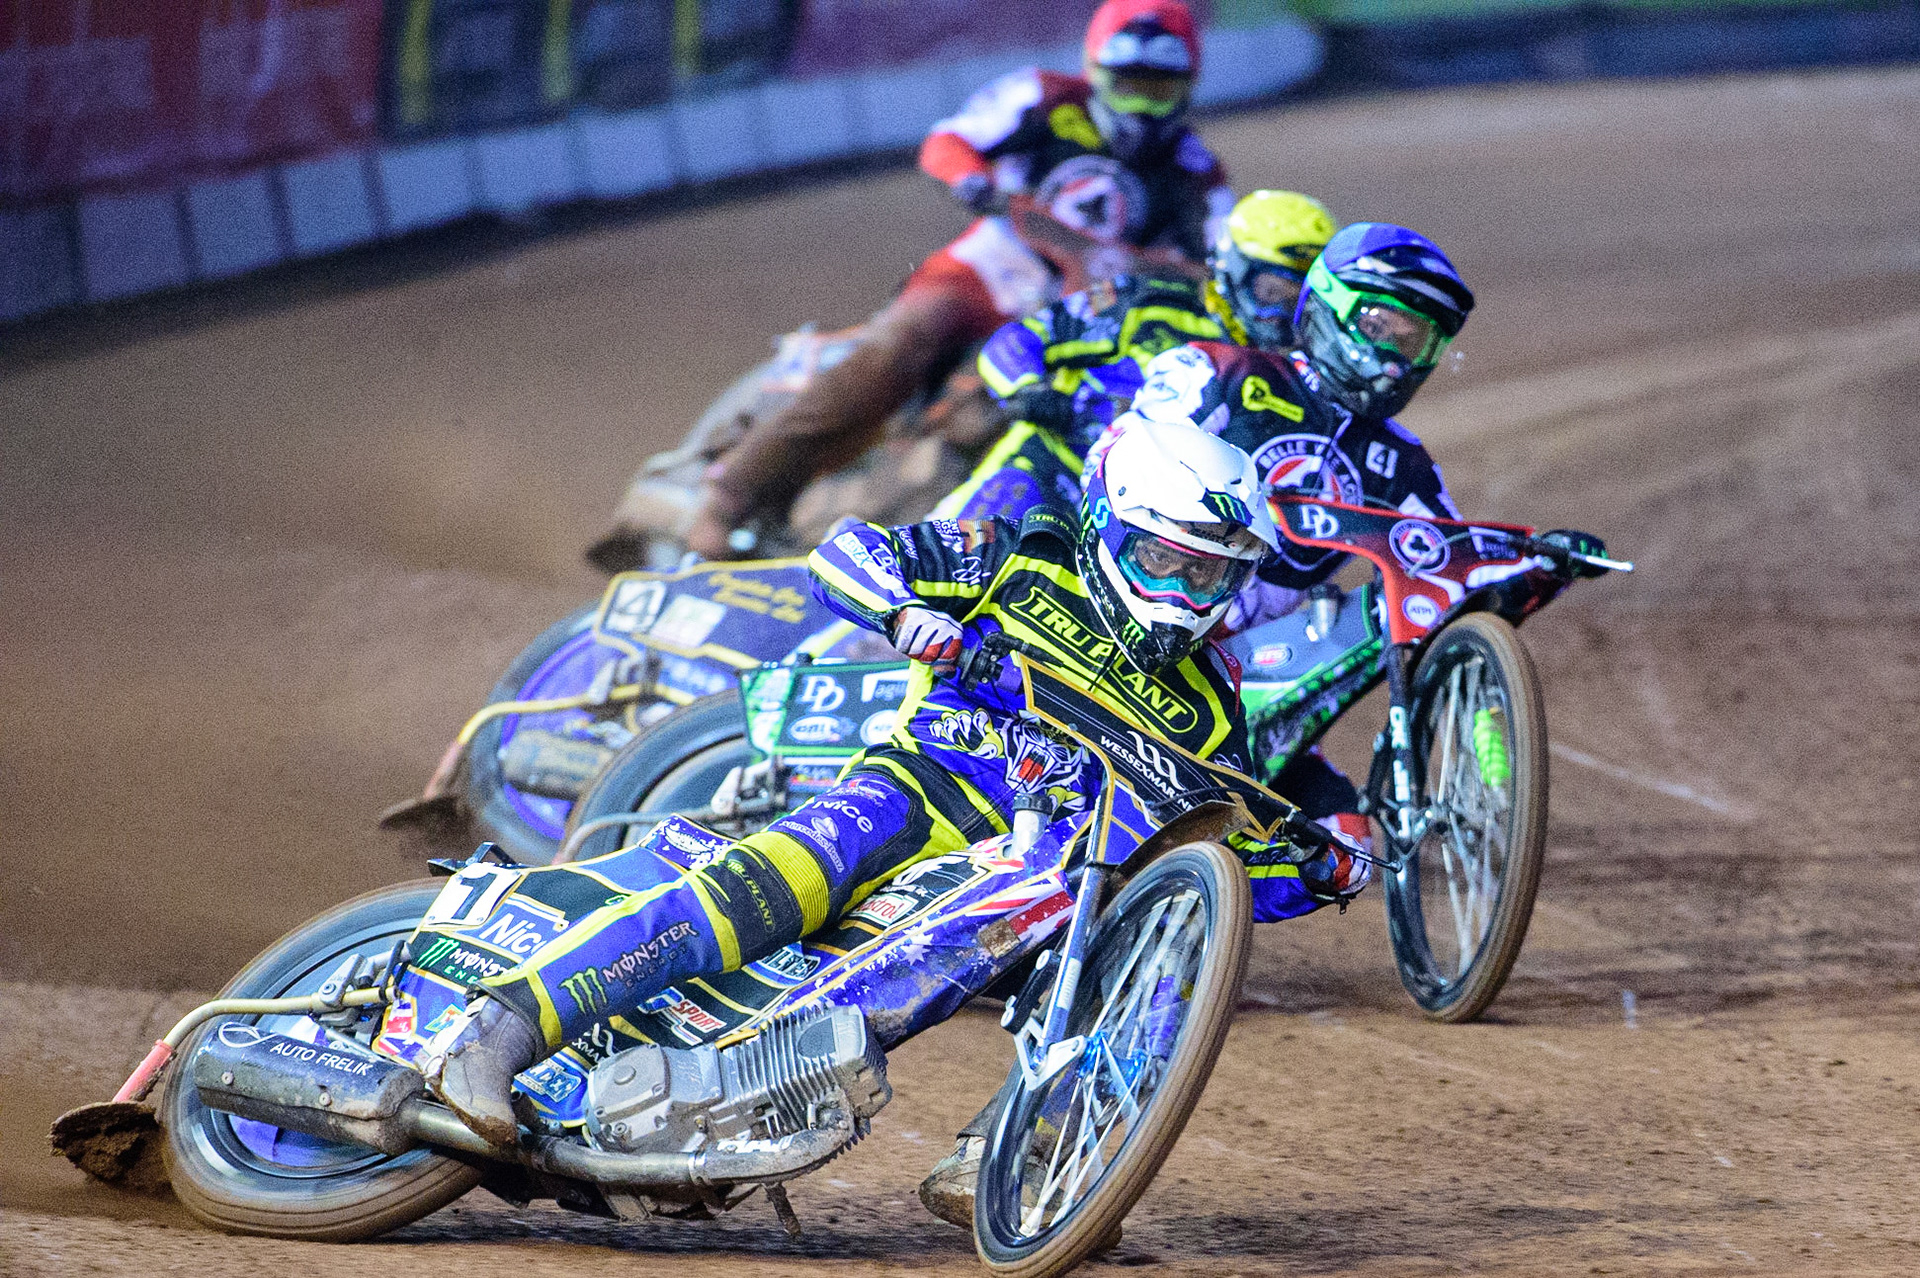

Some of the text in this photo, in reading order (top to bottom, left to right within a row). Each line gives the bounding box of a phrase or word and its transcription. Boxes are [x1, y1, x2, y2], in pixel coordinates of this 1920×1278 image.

[1258, 440, 1307, 470] BELLE
[615, 588, 657, 631] 4
[1029, 596, 1188, 721] TRU PLANT
[1099, 735, 1194, 811] WESSEXMARNE
[779, 819, 845, 874] Mercedes-Benz
[450, 871, 499, 920] 1
[746, 879, 774, 927] PLANT
[859, 898, 905, 920] strol
[443, 965, 479, 985] ENE
[672, 999, 724, 1031] SPORT
[269, 1041, 374, 1077] AUTO FRELIK
